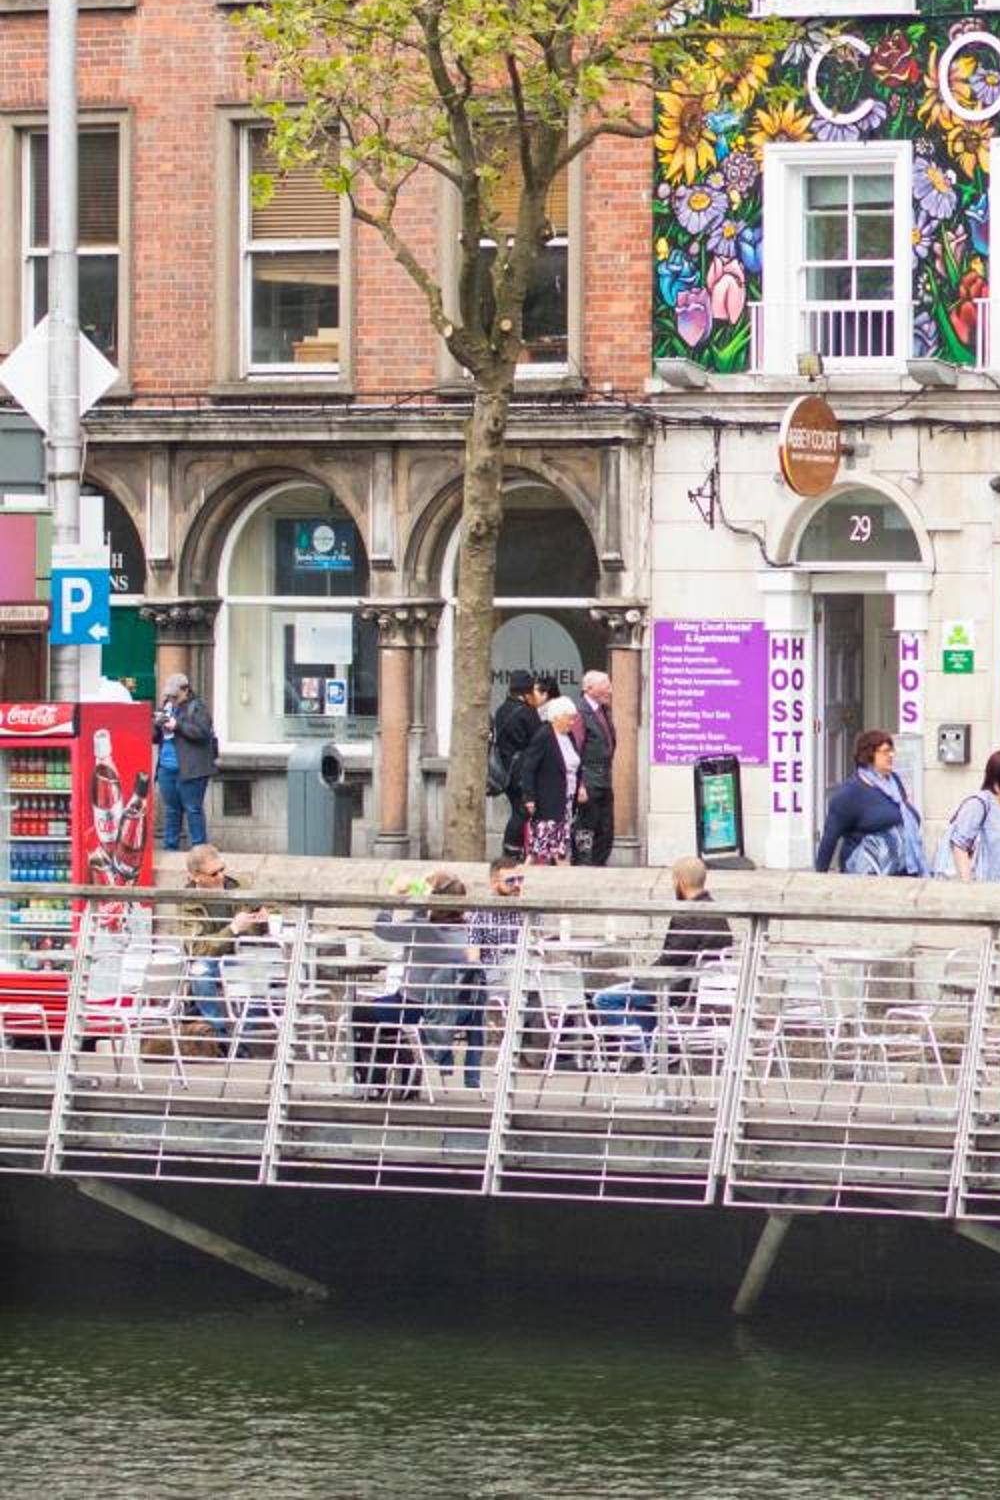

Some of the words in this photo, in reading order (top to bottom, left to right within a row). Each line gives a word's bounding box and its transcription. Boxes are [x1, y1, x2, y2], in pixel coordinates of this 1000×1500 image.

[849, 515, 872, 542] 29
[61, 577, 93, 635] P
[901, 638, 919, 723] HOS
[771, 638, 788, 813] HOSTEL
[792, 637, 804, 813] HOSTEL
